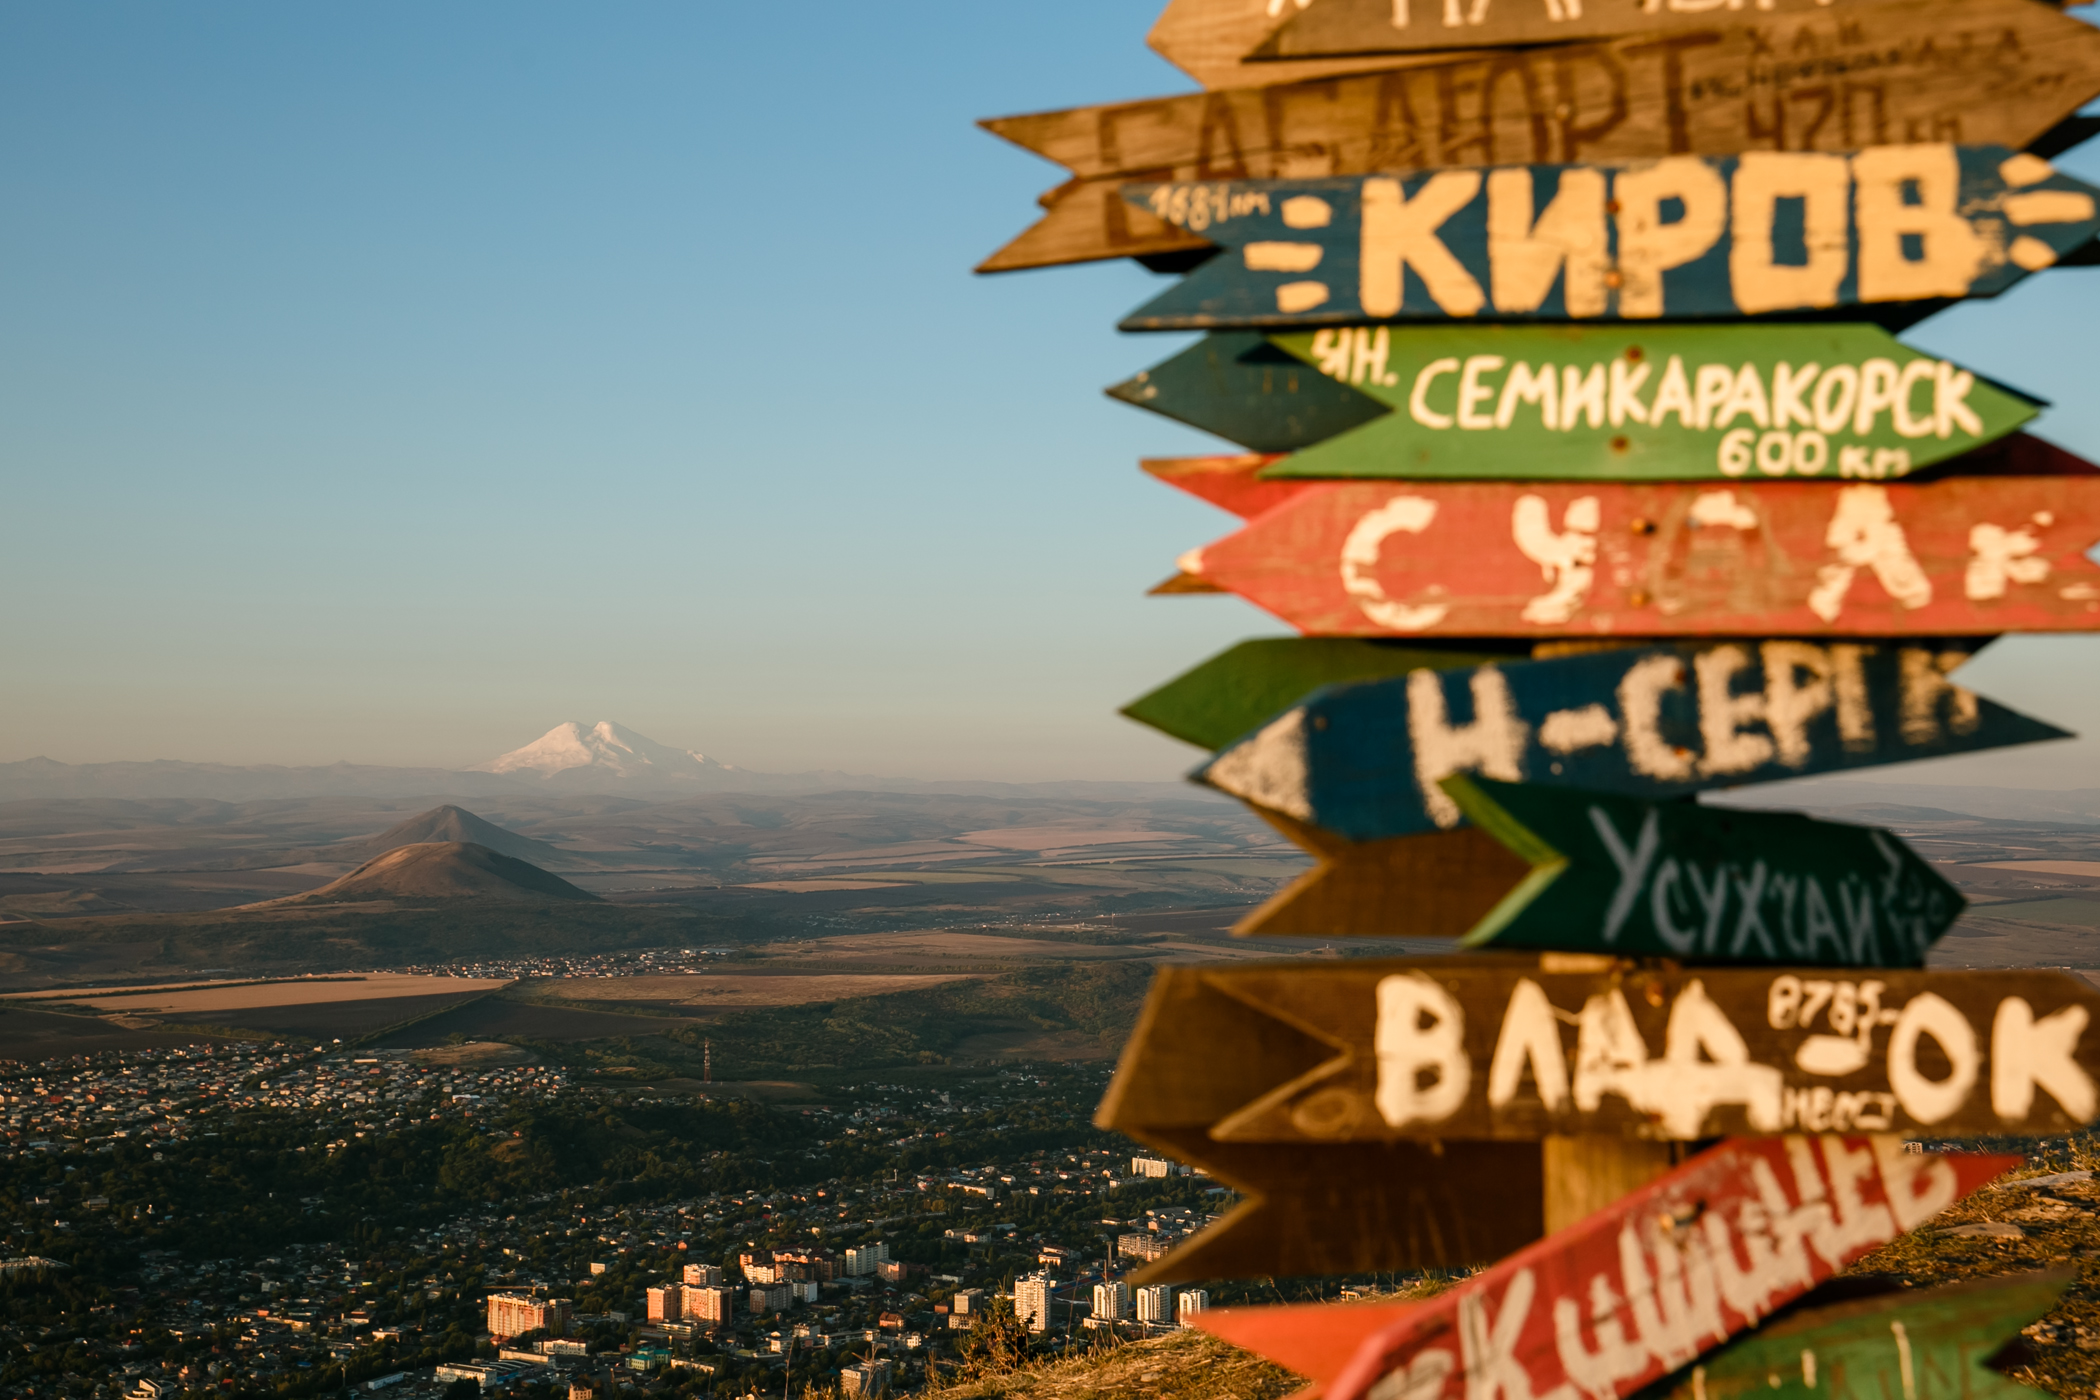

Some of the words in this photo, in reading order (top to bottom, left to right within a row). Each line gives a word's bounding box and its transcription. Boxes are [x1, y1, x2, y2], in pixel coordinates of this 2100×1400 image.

[1359, 144, 1986, 318] КИРОВ
[1409, 353, 1985, 440] СЕМИКАРАКОРСК
[1717, 430, 1828, 478] 600
